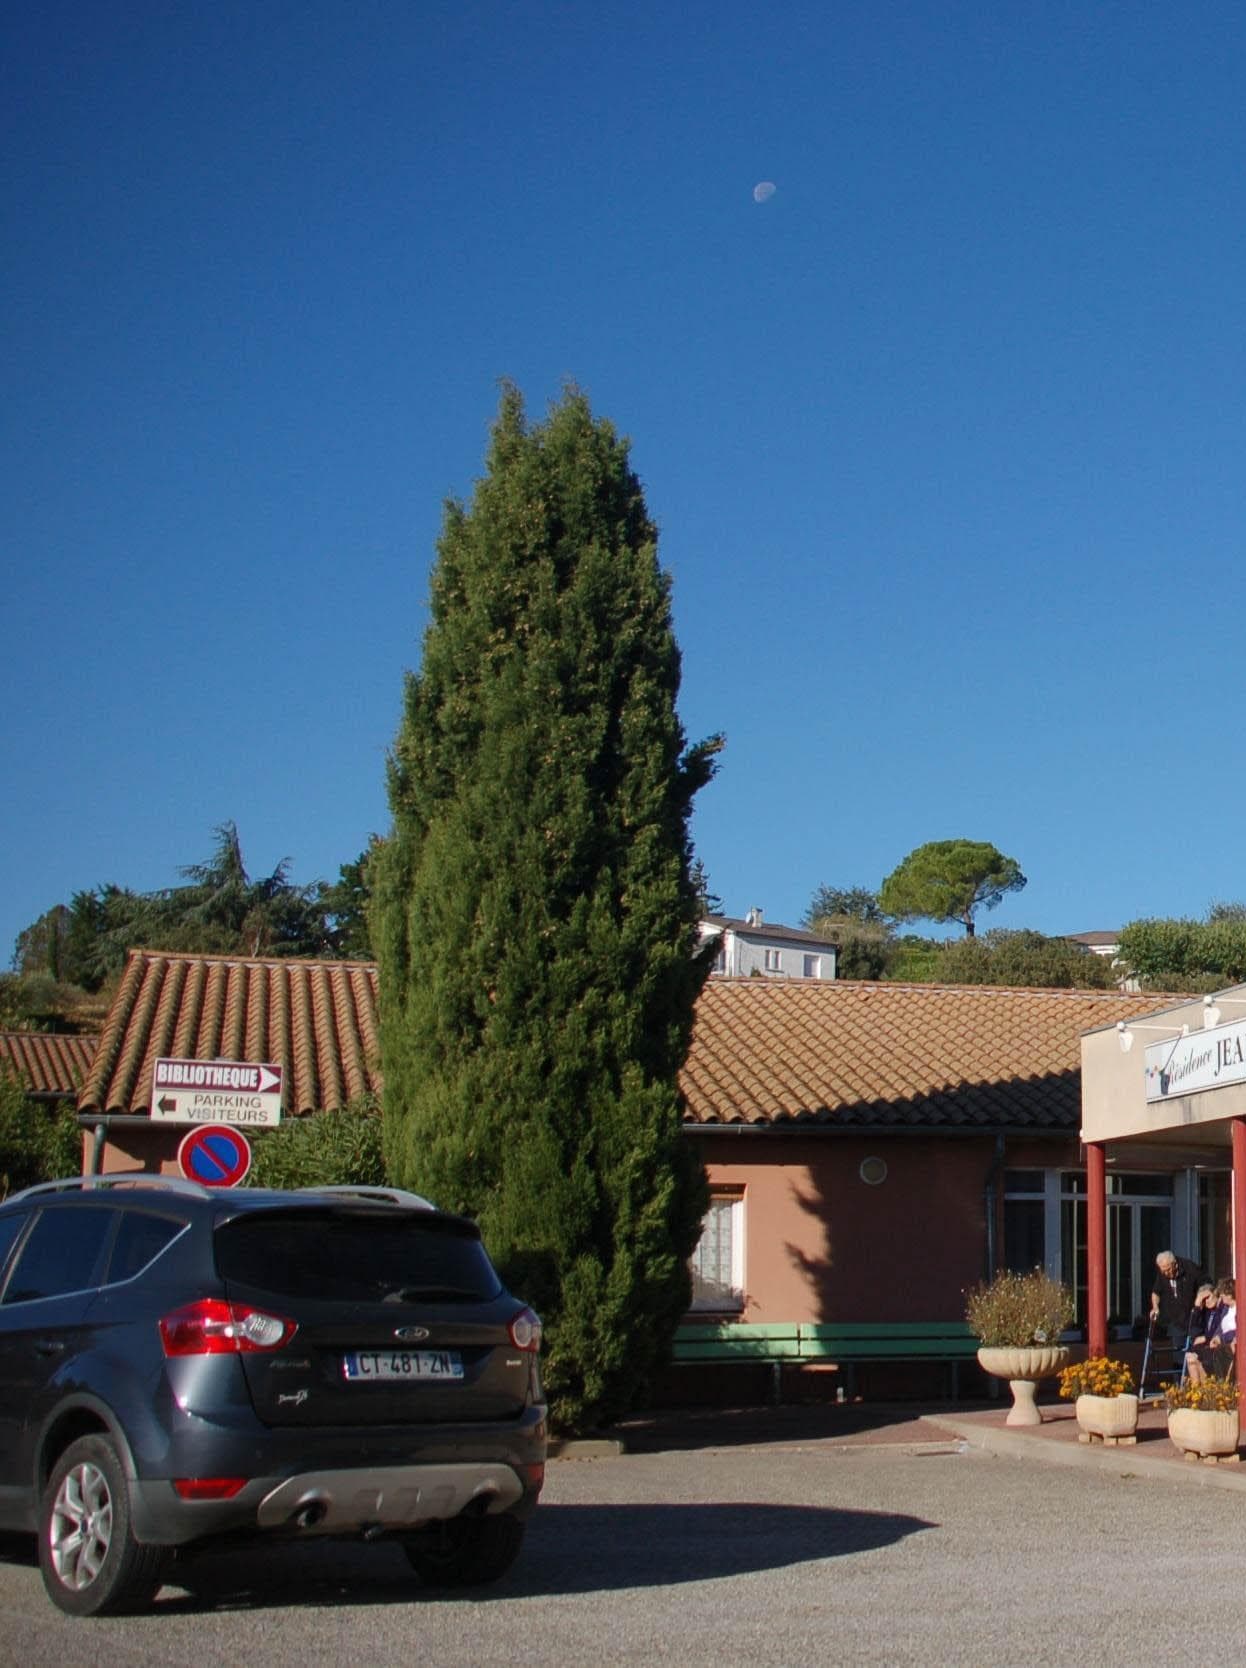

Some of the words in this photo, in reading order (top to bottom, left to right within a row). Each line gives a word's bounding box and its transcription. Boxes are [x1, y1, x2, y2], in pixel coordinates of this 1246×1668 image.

[157, 1063, 258, 1088] BIBLIOTHEQUE
[194, 1094, 262, 1108] PARKING
[187, 1107, 268, 1121] VISITEURS
